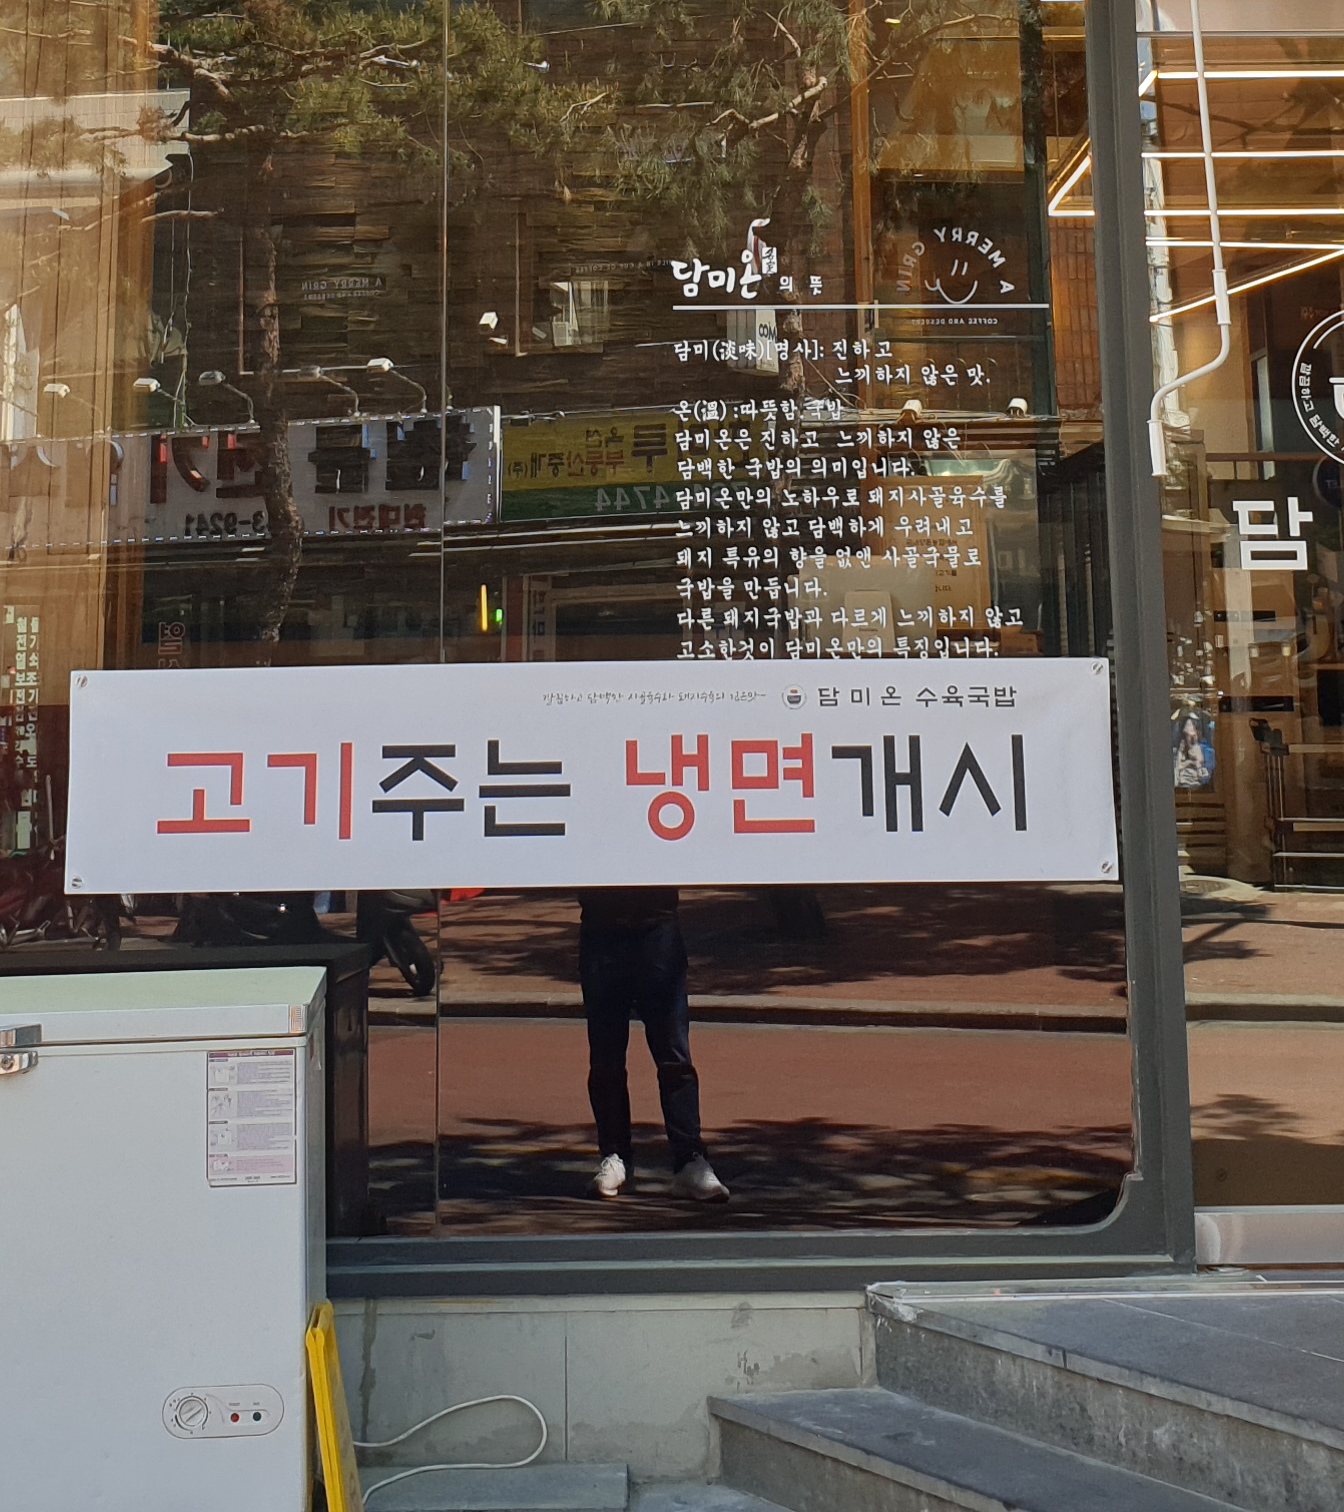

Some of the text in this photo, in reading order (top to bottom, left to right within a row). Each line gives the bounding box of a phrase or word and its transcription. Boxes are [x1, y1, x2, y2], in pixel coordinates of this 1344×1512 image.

[670, 249, 823, 299] 담미온 의 뜻
[833, 340, 892, 359] 진하고
[836, 366, 991, 385] 느끼하지 않은 맛.
[676, 429, 961, 450] 담미온은 진하고 느끼하지 않은
[677, 458, 915, 480] 담백한 국밥의 의미입니다.
[676, 486, 1007, 510] 담미온만의 노하우로 돼지사골육수를
[676, 515, 973, 538] 느끼하지 않고 담백하게 우려내고
[676, 547, 982, 569] 돼지 특유의 향을 없앤 사골국물로
[676, 577, 827, 600] 국밥을 만듭니다.
[676, 607, 1023, 629] 다른 돼지국밥과 다르게 느끼하지 않고
[677, 637, 999, 659] 고소한것이 담미온만의 특징입니다.
[818, 684, 1018, 708] 담미온 수육국밥
[156, 731, 1029, 843] 고기주는 냉면개시
